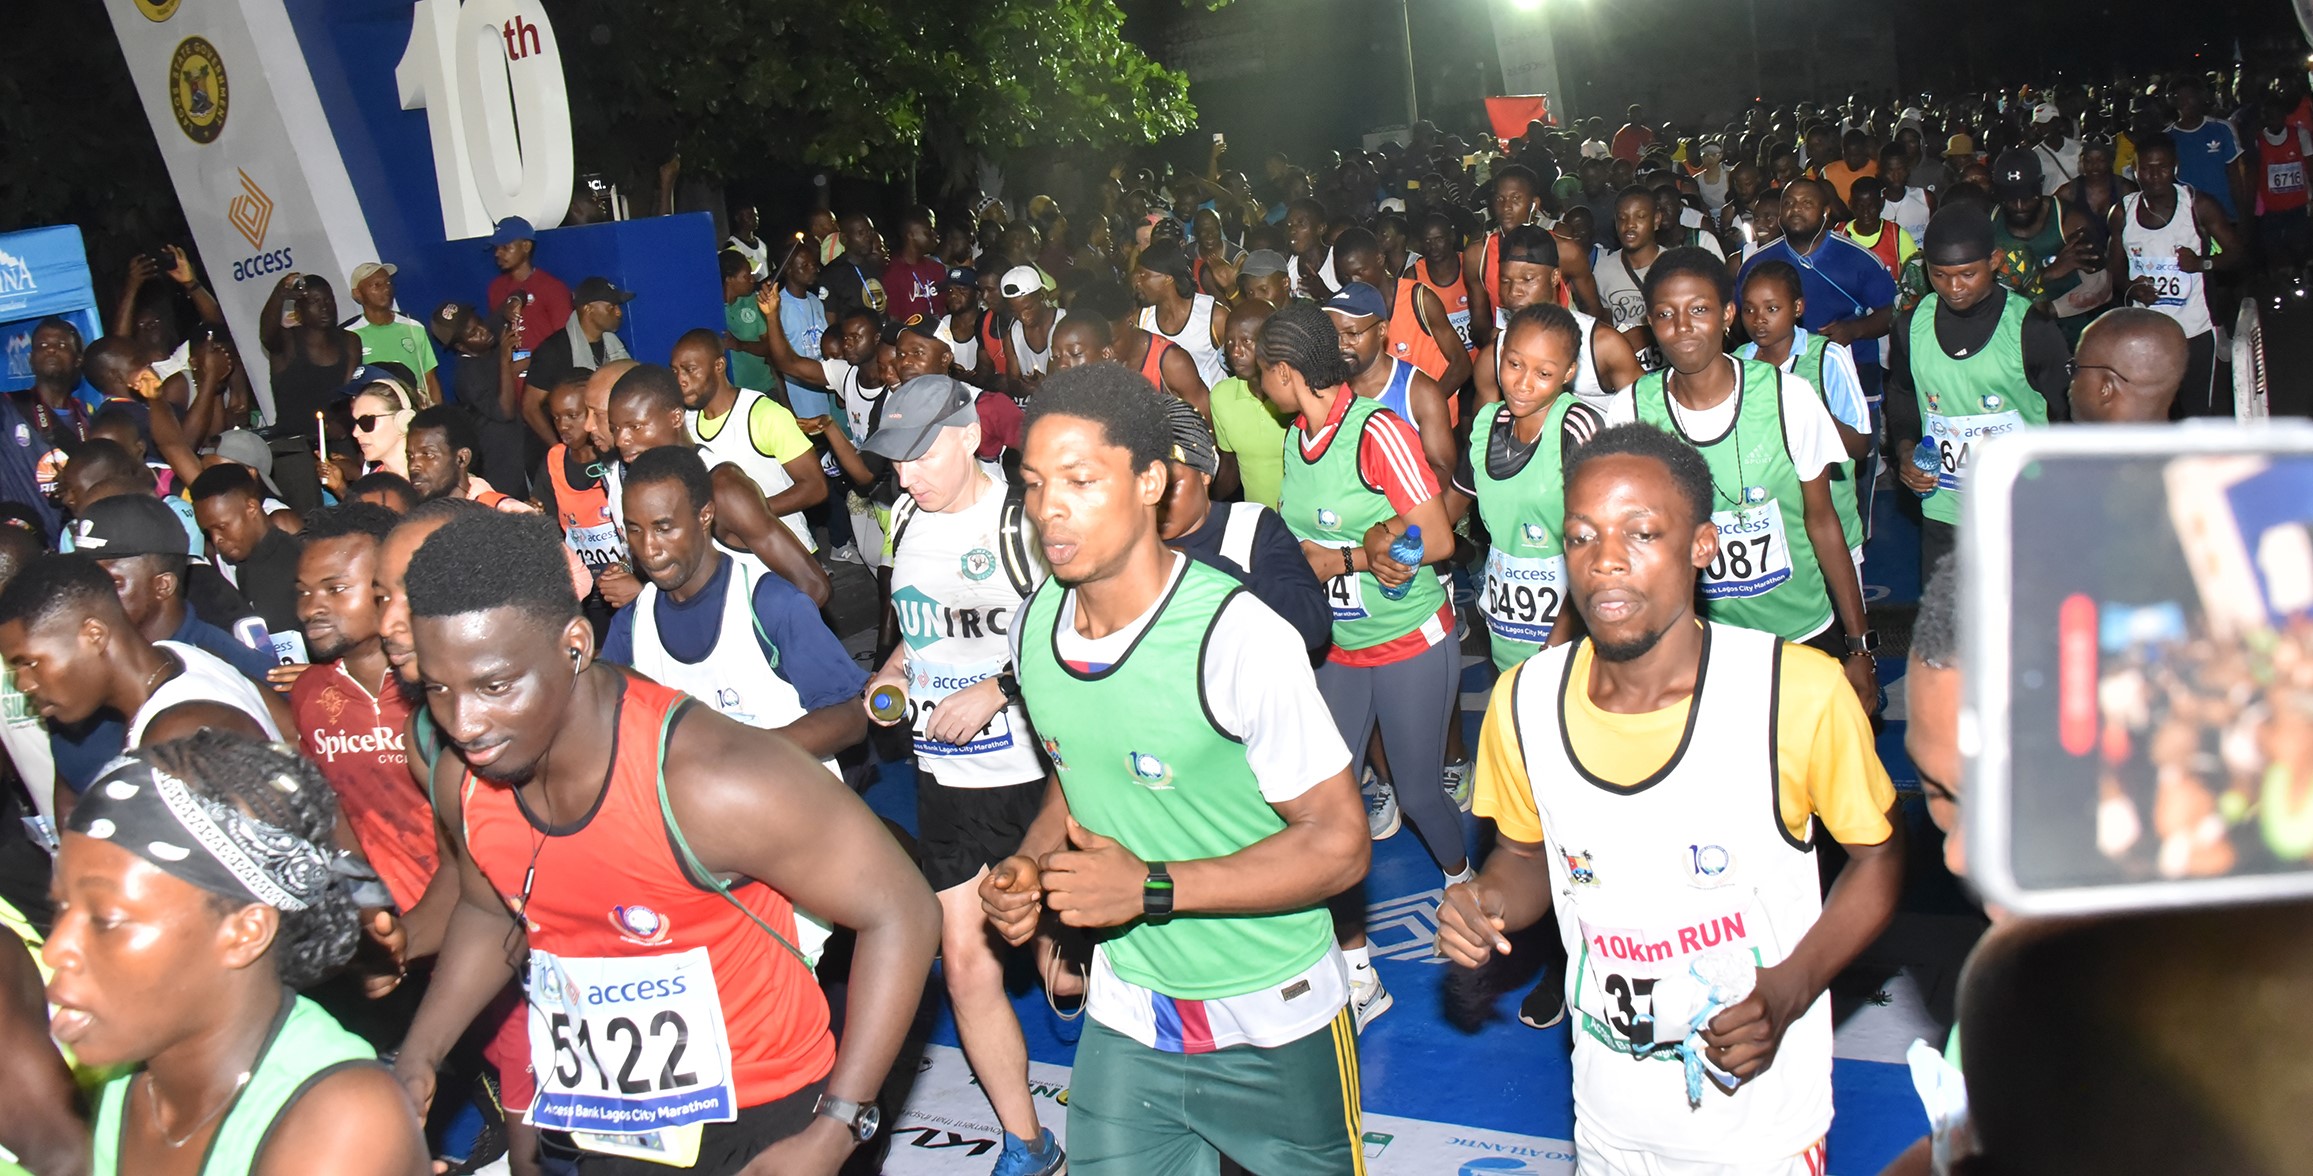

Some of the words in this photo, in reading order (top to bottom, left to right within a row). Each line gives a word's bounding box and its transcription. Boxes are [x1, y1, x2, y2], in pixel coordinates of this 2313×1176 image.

[2273, 171, 2301, 187] 6716
[233, 247, 293, 281] access
[1717, 517, 1770, 535] access
[587, 530, 618, 543] access
[1505, 567, 1555, 582] access
[1718, 583, 1738, 593] Lagos
[1739, 582, 1754, 594] City
[1754, 574, 1786, 590] Marathon
[1488, 574, 1559, 623] 6492
[1505, 625, 1524, 635] Lagos
[1524, 628, 1537, 637] City
[974, 739, 1008, 750] Marathon
[1594, 935, 1673, 962] 10km
[1677, 912, 1746, 954] RUN
[588, 975, 687, 1005] access
[552, 1010, 699, 1095] 5122
[575, 1105, 599, 1118] Bank
[601, 1106, 631, 1123] Lagos
[632, 1108, 656, 1121] City
[658, 1097, 719, 1118] Marathon
[932, 1115, 953, 1127] that
[1445, 1136, 1541, 1157] ATLANTIC
